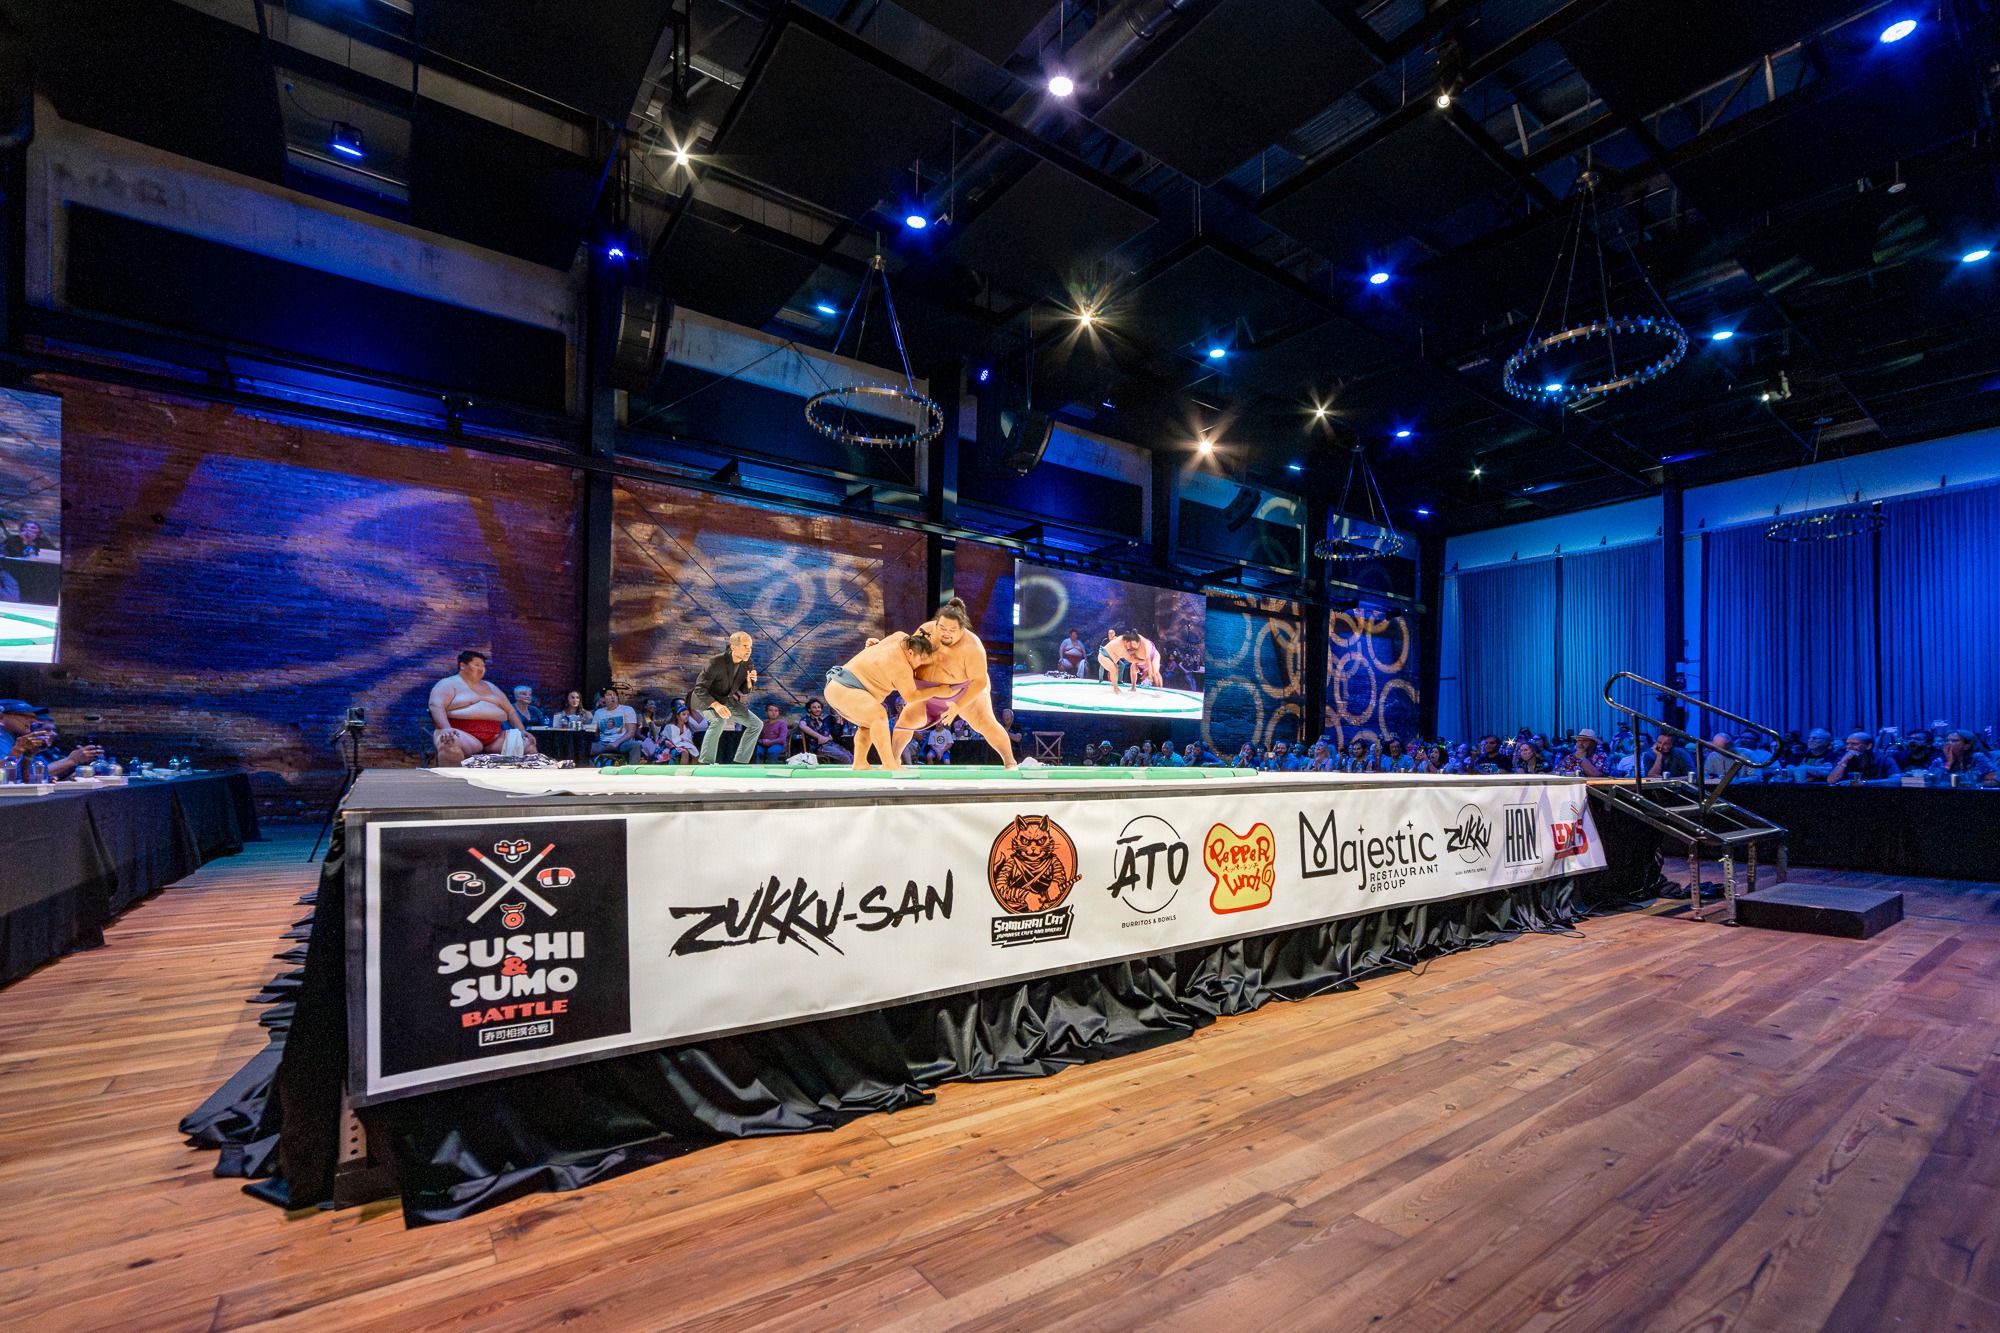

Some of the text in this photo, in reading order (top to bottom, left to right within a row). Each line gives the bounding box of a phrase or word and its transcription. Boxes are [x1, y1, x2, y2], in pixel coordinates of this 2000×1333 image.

[1299, 809, 1437, 890] Majestic
[1443, 814, 1492, 859] ZUKKU
[1505, 807, 1540, 863] HAN
[1222, 868, 1260, 896] Lunch
[1370, 863, 1440, 882] RESTAURANT
[1370, 879, 1406, 893] GROUP
[667, 868, 954, 957] ZUKKU-SAN
[1121, 918, 1152, 928] BURRITOS
[1157, 914, 1177, 923] BOWLS
[437, 931, 585, 974] SUSHI
[501, 955, 528, 977] &
[449, 966, 578, 1008] SUMO
[461, 999, 569, 1028] BATTLE
